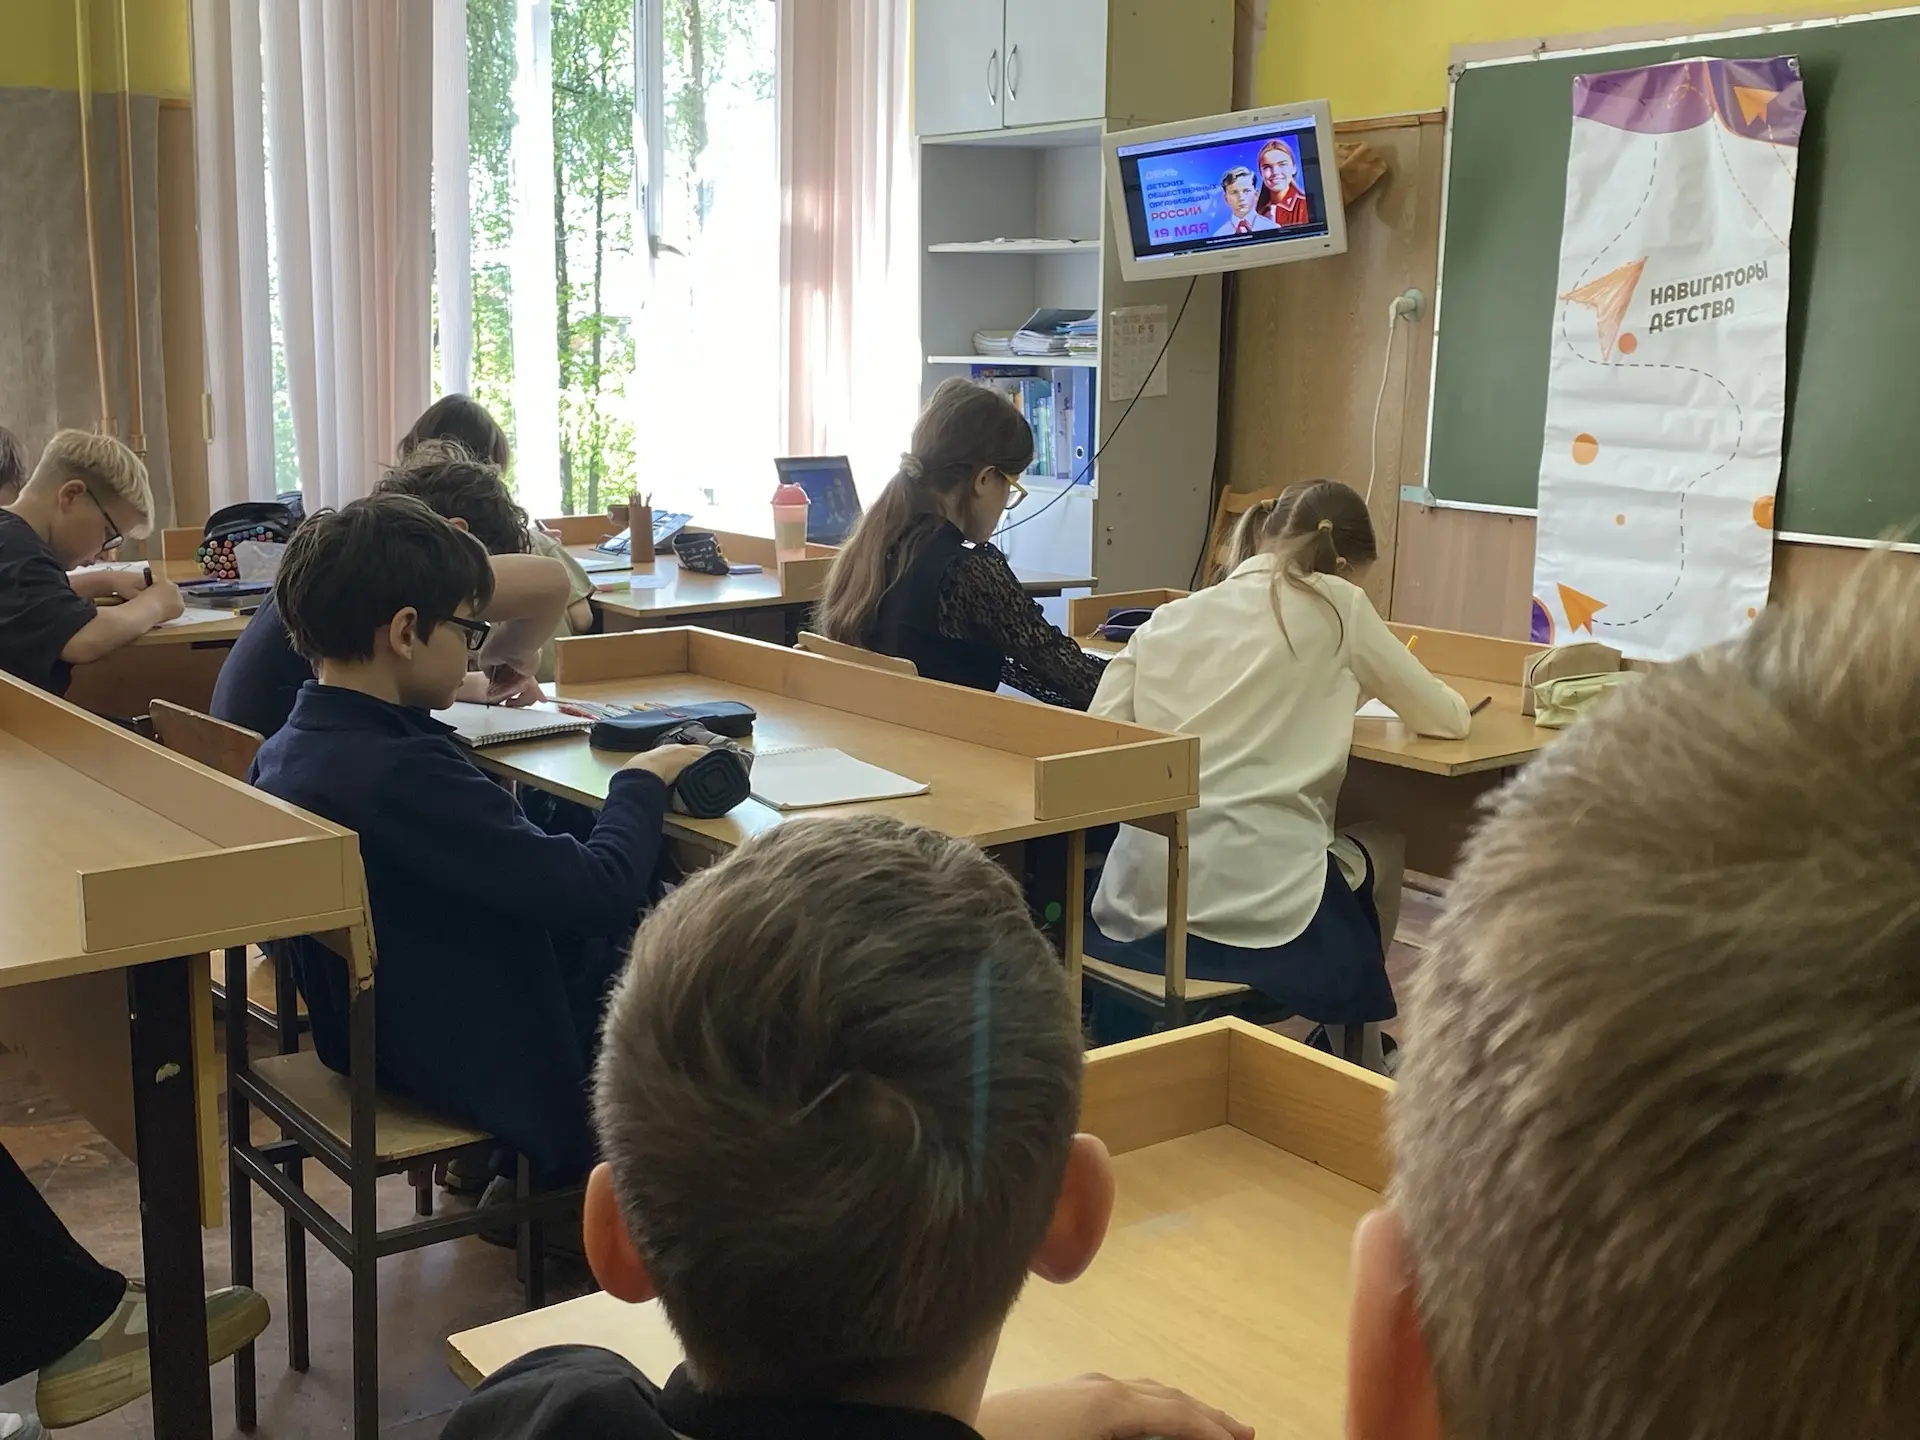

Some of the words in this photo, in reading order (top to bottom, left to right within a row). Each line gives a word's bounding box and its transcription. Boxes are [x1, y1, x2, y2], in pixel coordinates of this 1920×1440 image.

[1146, 179, 1185, 191] ДЕТСКИХ
[1148, 183, 1217, 199] ОБЩЕСТВЕННЫХ
[1151, 206, 1202, 221] РОССИИ
[1154, 228, 1169, 238] 19
[1174, 222, 1209, 237] МАЯ
[1650, 260, 1768, 306] НАВИГАТОРЫ
[1649, 297, 1735, 334] ДЕТСТВА
